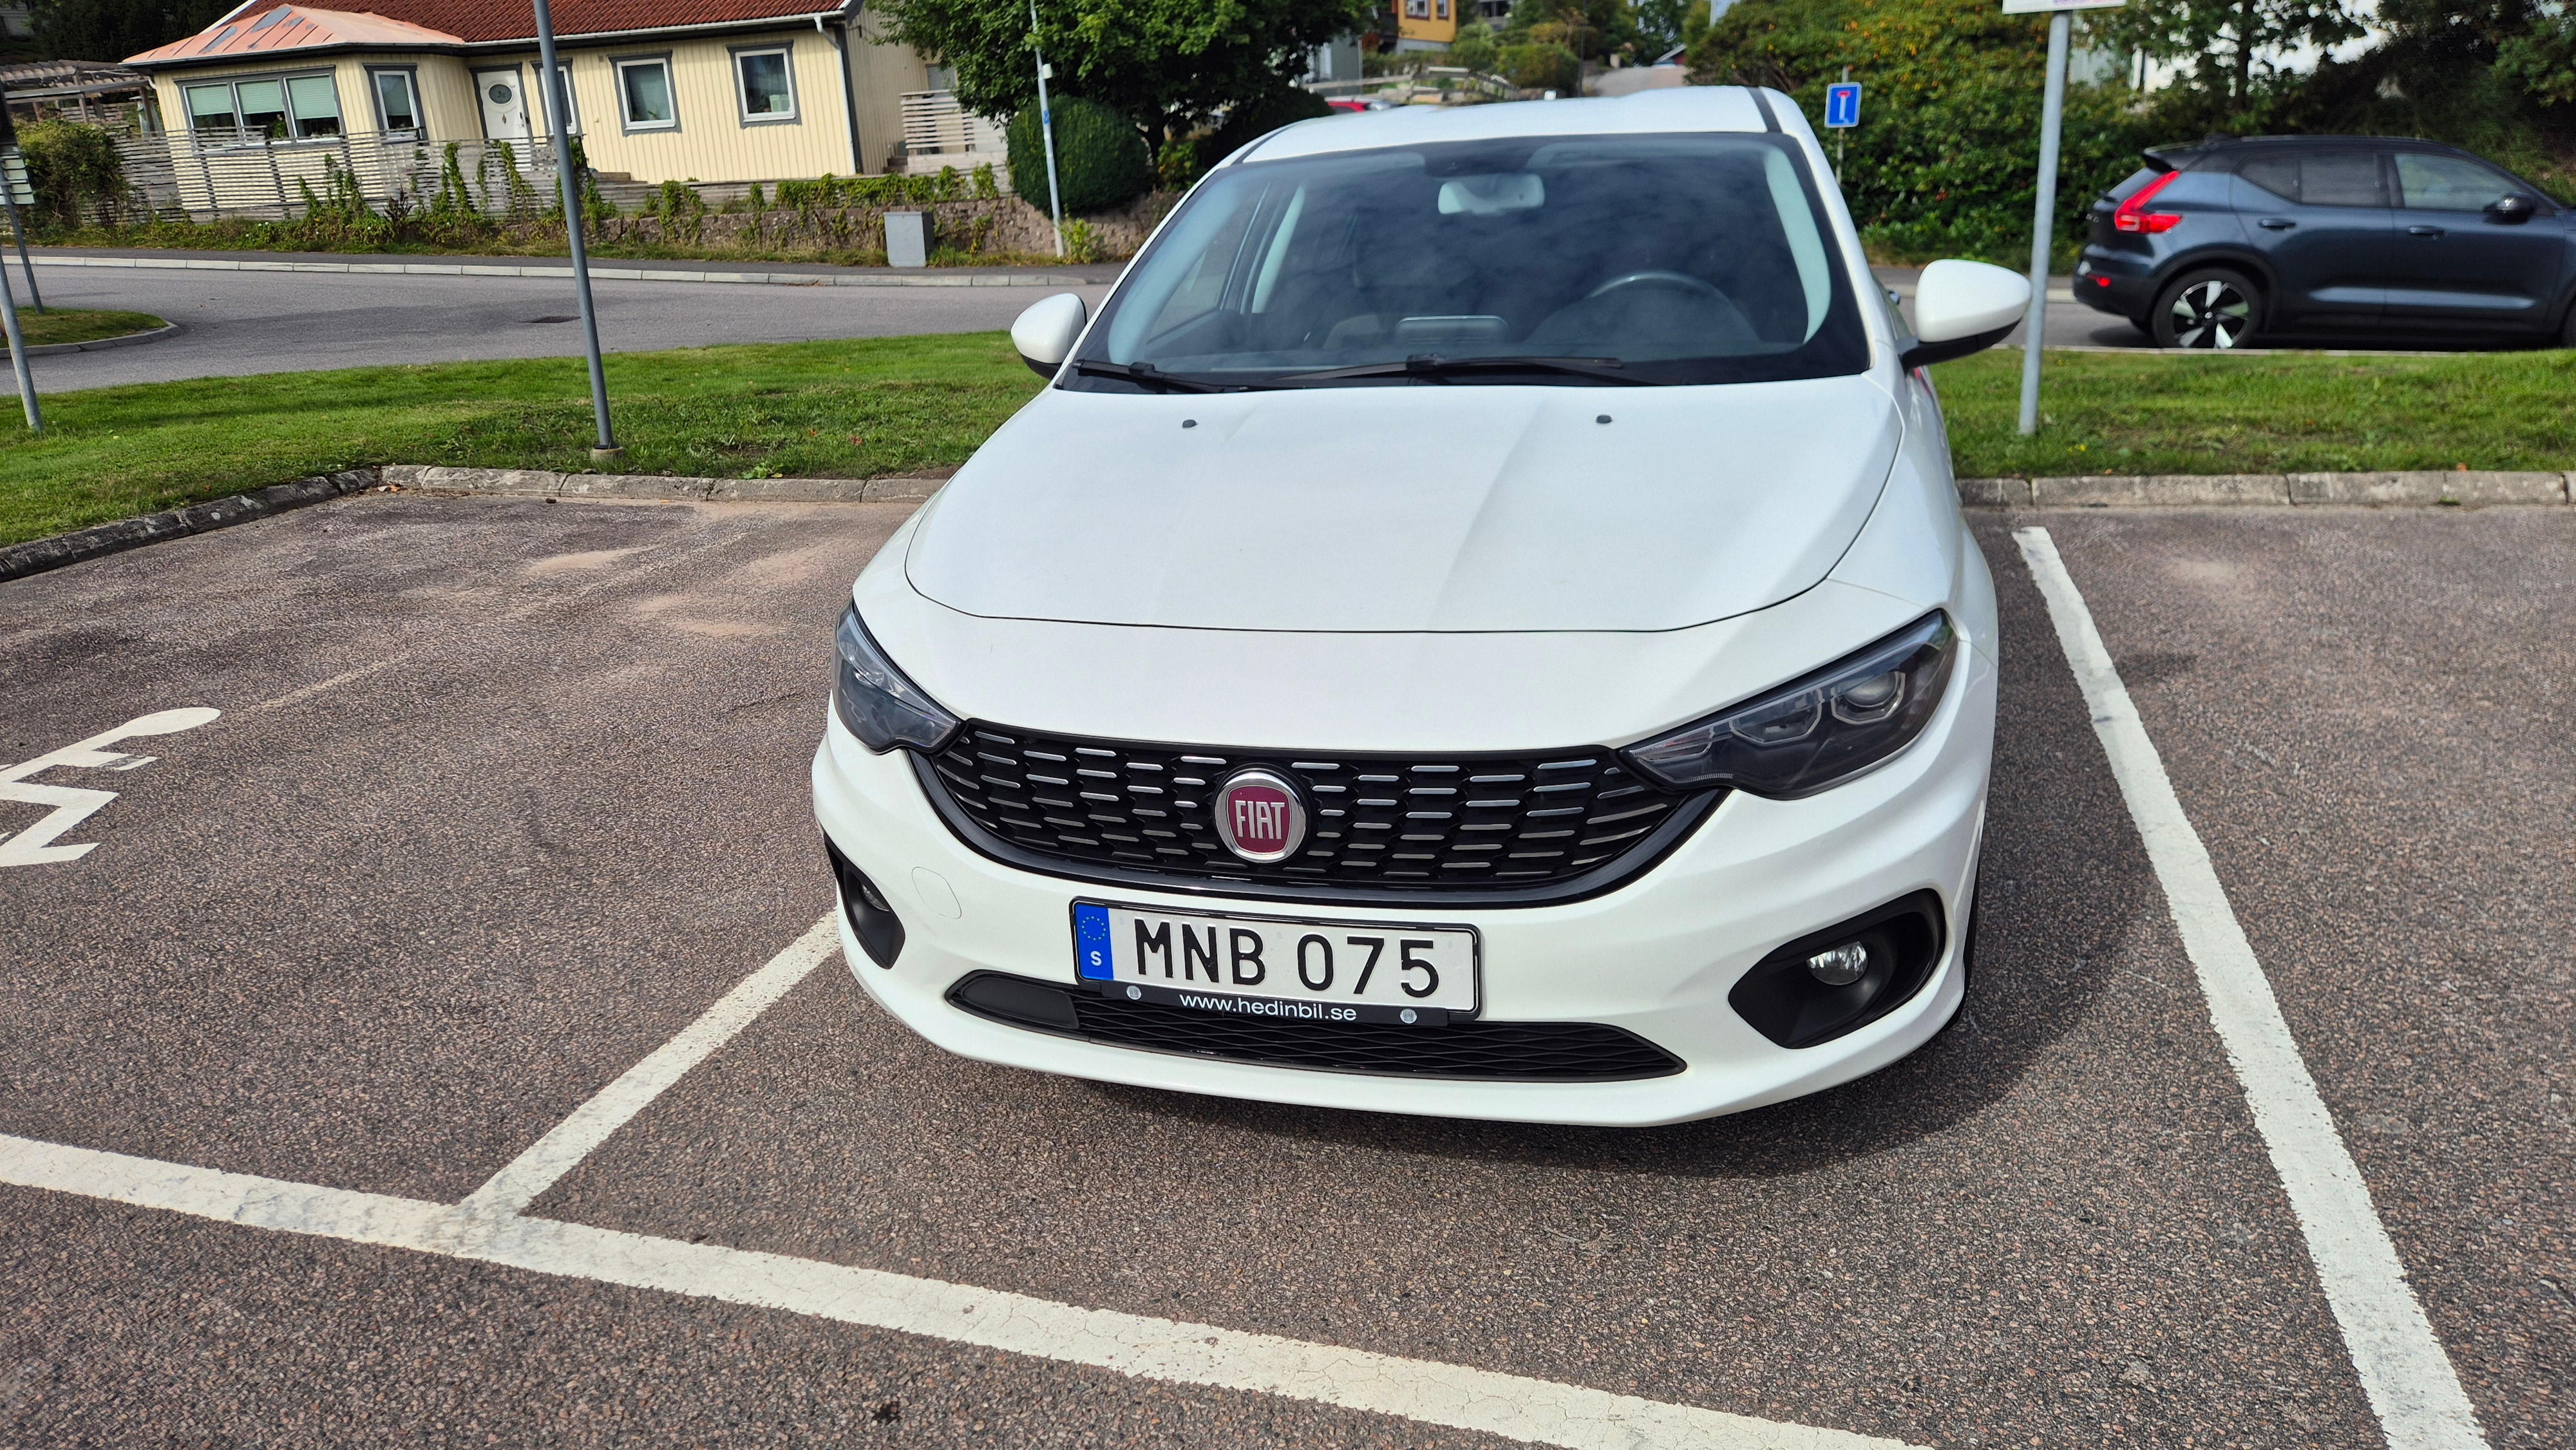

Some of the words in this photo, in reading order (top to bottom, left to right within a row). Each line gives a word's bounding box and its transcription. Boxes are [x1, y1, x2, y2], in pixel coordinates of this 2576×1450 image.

[1235, 800, 1285, 840] FIAT
[1090, 950, 1103, 966] S
[1134, 918, 1266, 986] MNB
[1297, 934, 1439, 998] 075
[1179, 993, 1358, 1021] www.hedinbil.se
